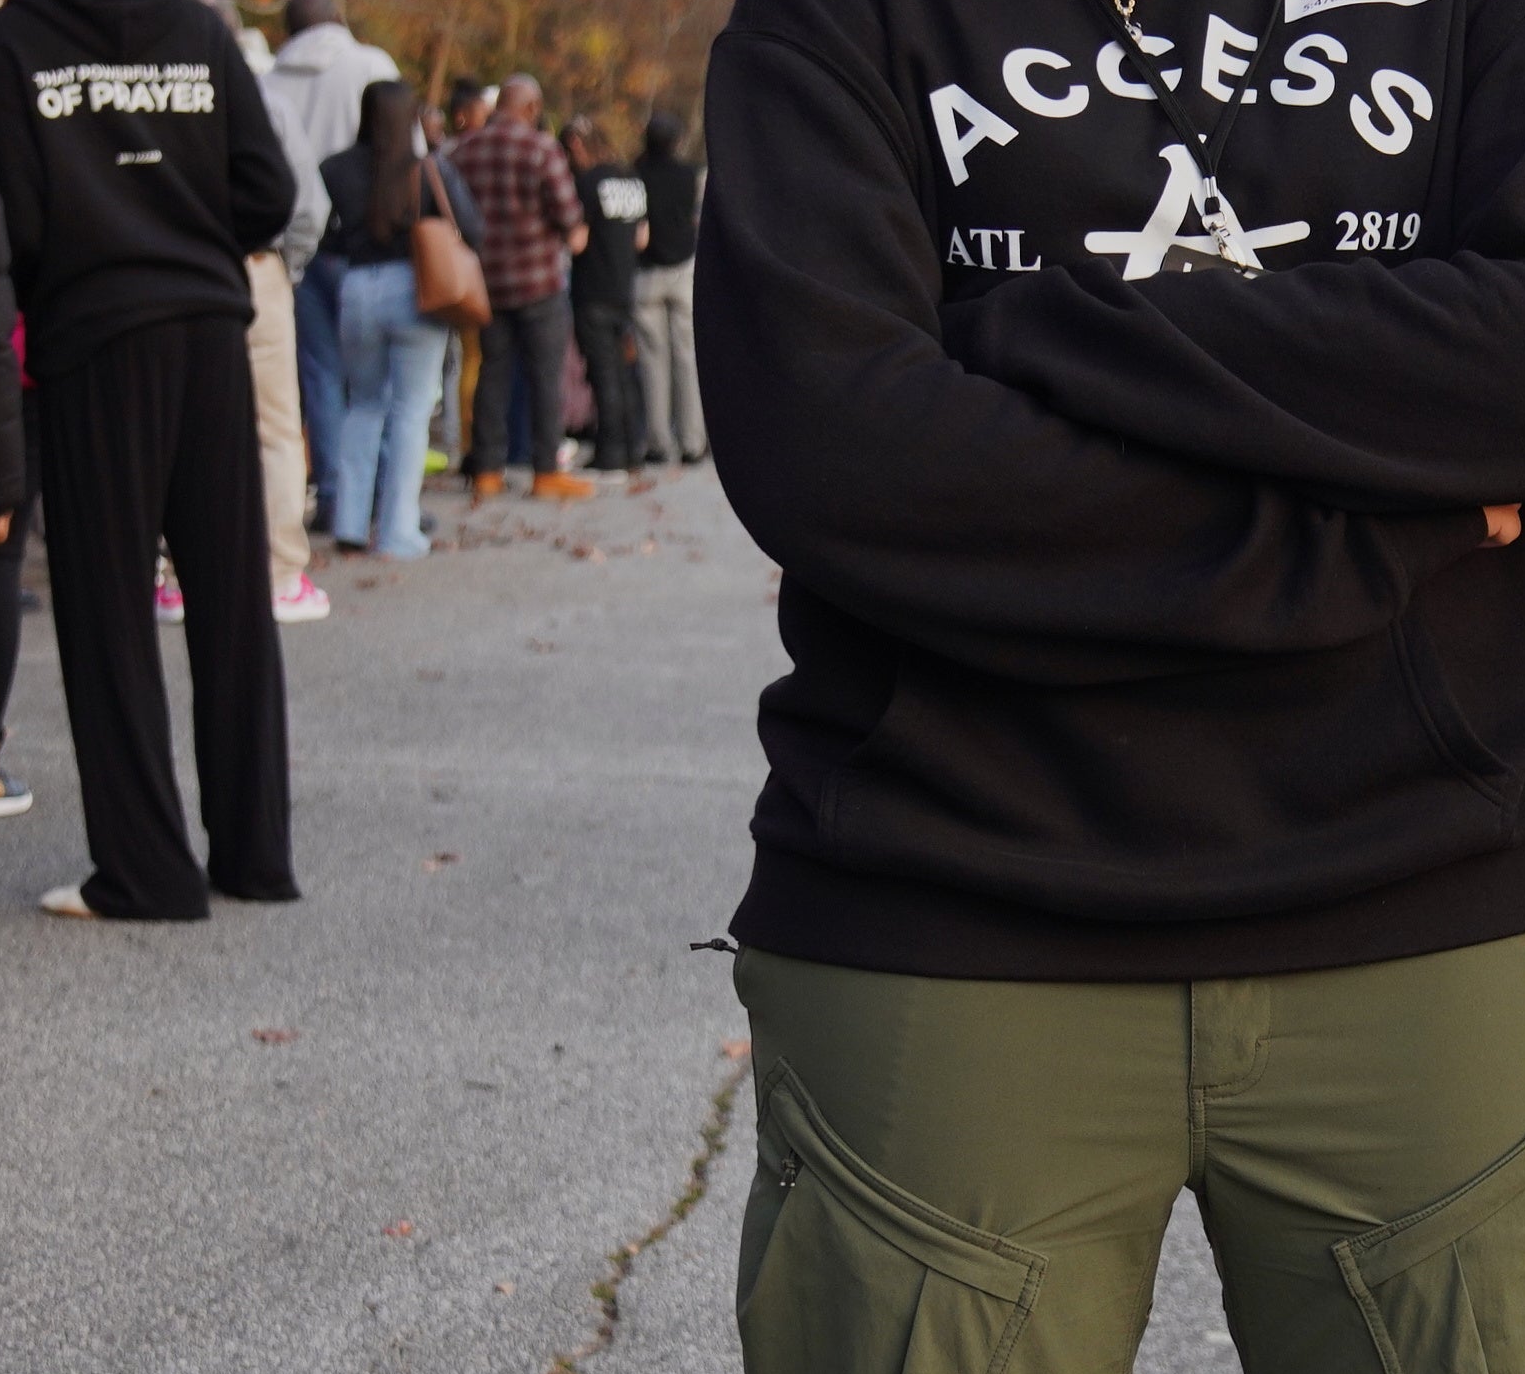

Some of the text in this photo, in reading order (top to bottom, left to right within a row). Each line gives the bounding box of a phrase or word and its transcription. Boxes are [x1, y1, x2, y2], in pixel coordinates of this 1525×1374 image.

[37, 81, 215, 119] OF PRAYER
[929, 13, 1434, 187] ACCESS
[946, 226, 1042, 272] ATL
[1335, 211, 1421, 252] 2819
